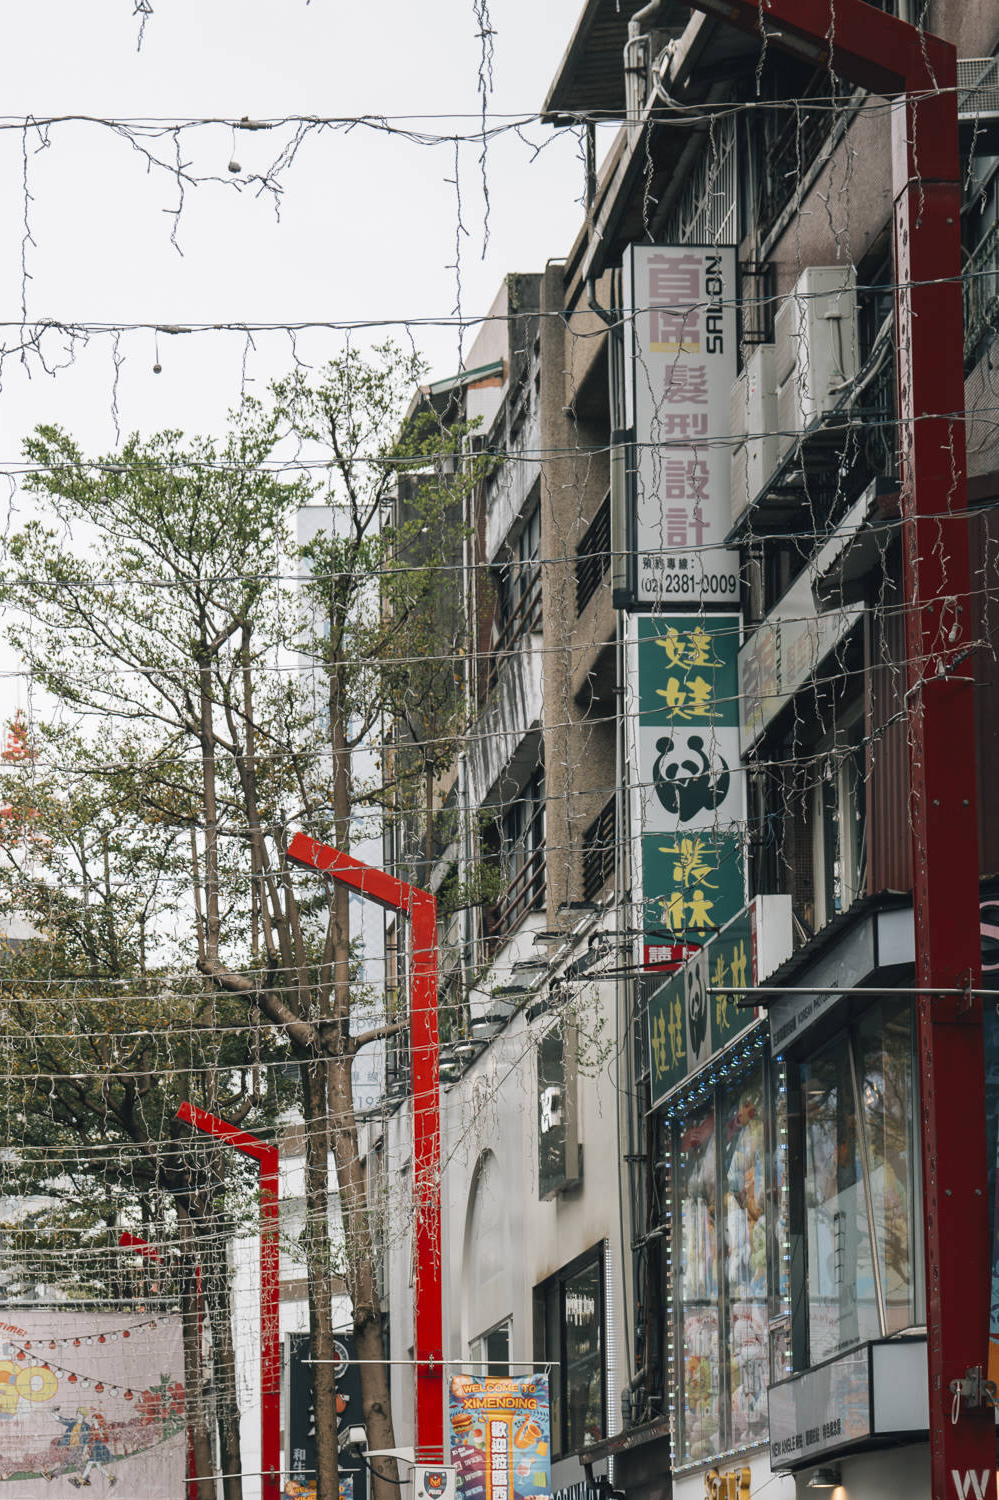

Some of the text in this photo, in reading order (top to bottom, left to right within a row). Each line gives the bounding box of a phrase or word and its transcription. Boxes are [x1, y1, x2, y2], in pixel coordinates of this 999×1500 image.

[706, 255, 723, 354] SALON
[663, 365, 710, 547] 髮型設計
[665, 573, 736, 594] 2381-0009
[655, 625, 723, 720] 娃娃
[463, 1383, 537, 1394] WELCOME TO
[463, 1398, 538, 1410] XIMENDING
[952, 1469, 990, 1500] W
